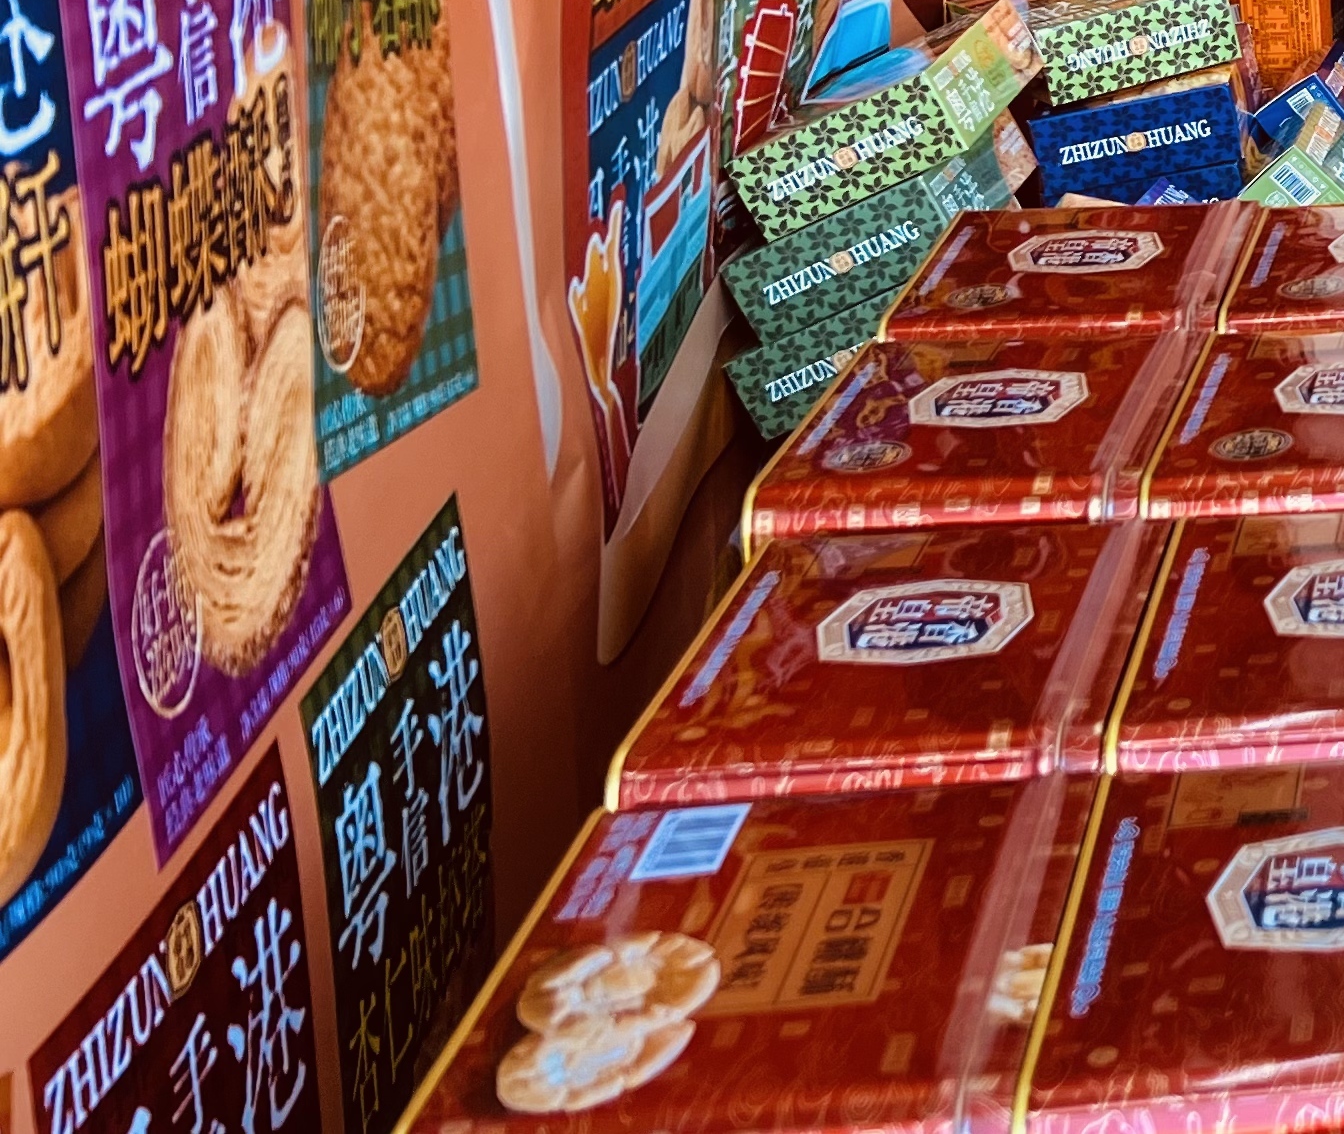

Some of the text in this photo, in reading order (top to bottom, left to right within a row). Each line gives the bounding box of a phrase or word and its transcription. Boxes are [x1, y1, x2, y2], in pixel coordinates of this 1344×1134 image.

[766, 115, 925, 202] ZHIZUN HUANG
[1059, 119, 1212, 165] ZHIZUN HUANG
[762, 220, 921, 306] ZHIZUN HUANG
[765, 354, 838, 404] ZHIZUN
[311, 525, 467, 786] ZHIZUN HUANG
[199, 782, 290, 972] HUANG
